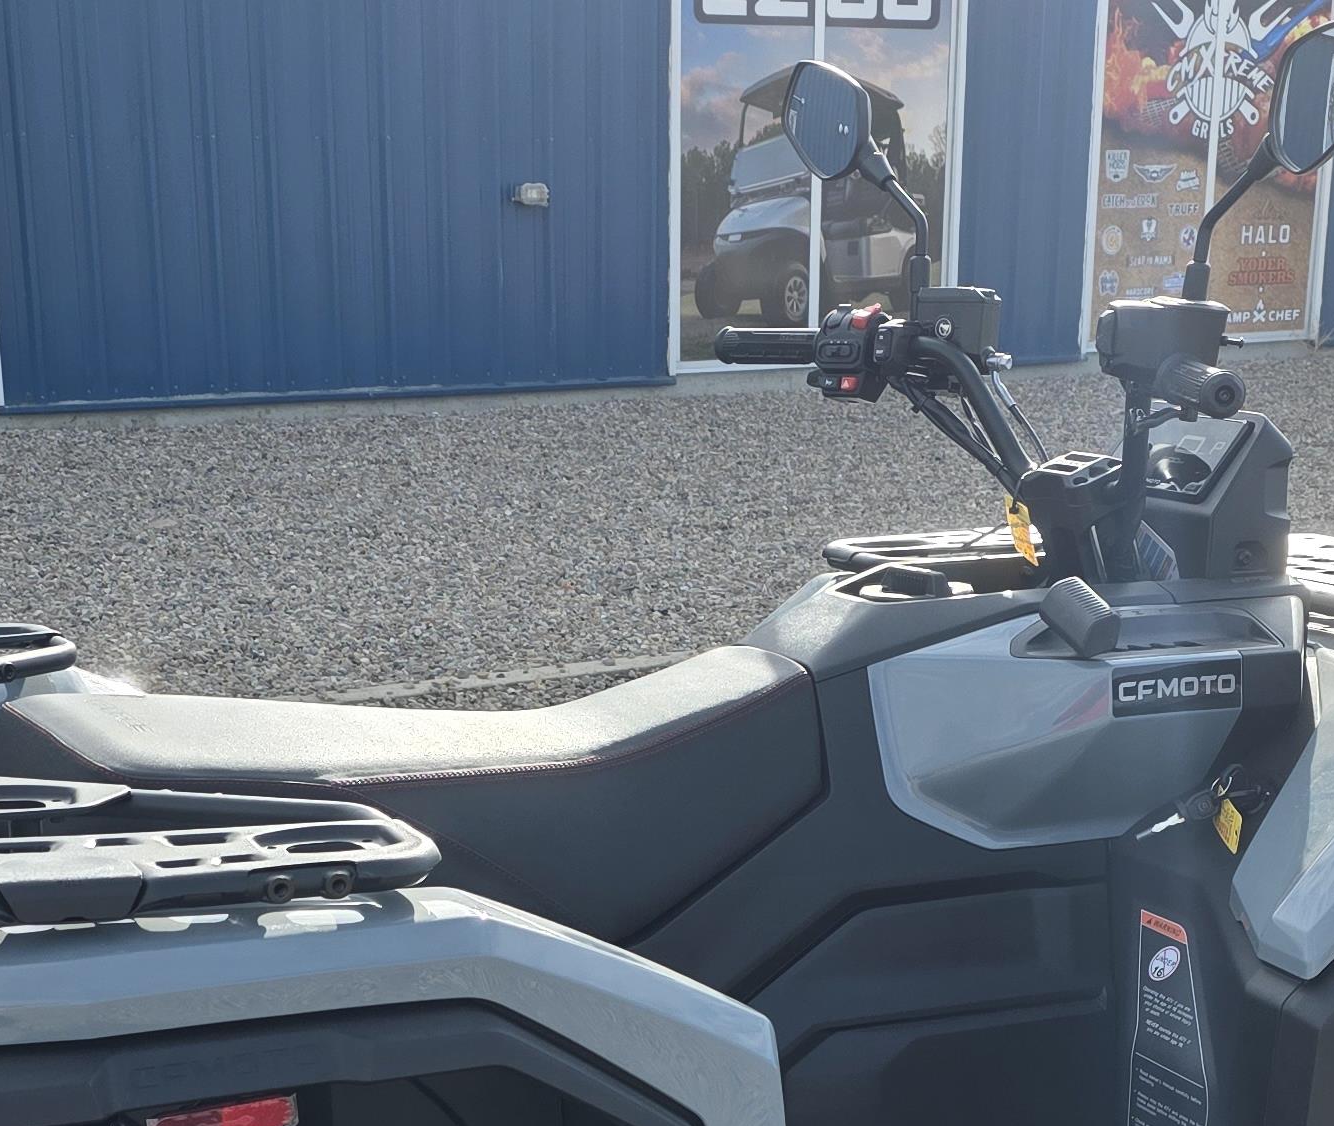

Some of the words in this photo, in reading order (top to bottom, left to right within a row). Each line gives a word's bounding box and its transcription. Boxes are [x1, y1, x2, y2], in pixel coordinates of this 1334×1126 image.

[1192, 119, 1235, 139] GRLS
[1169, 203, 1199, 216] TRUFF
[1241, 224, 1291, 245] HALO
[1237, 257, 1287, 271] YODER
[1228, 271, 1296, 285] SMOKERS
[1226, 311, 1251, 323] AMP
[1268, 309, 1301, 322] CHEF
[1118, 675, 1236, 702] CFMOTO
